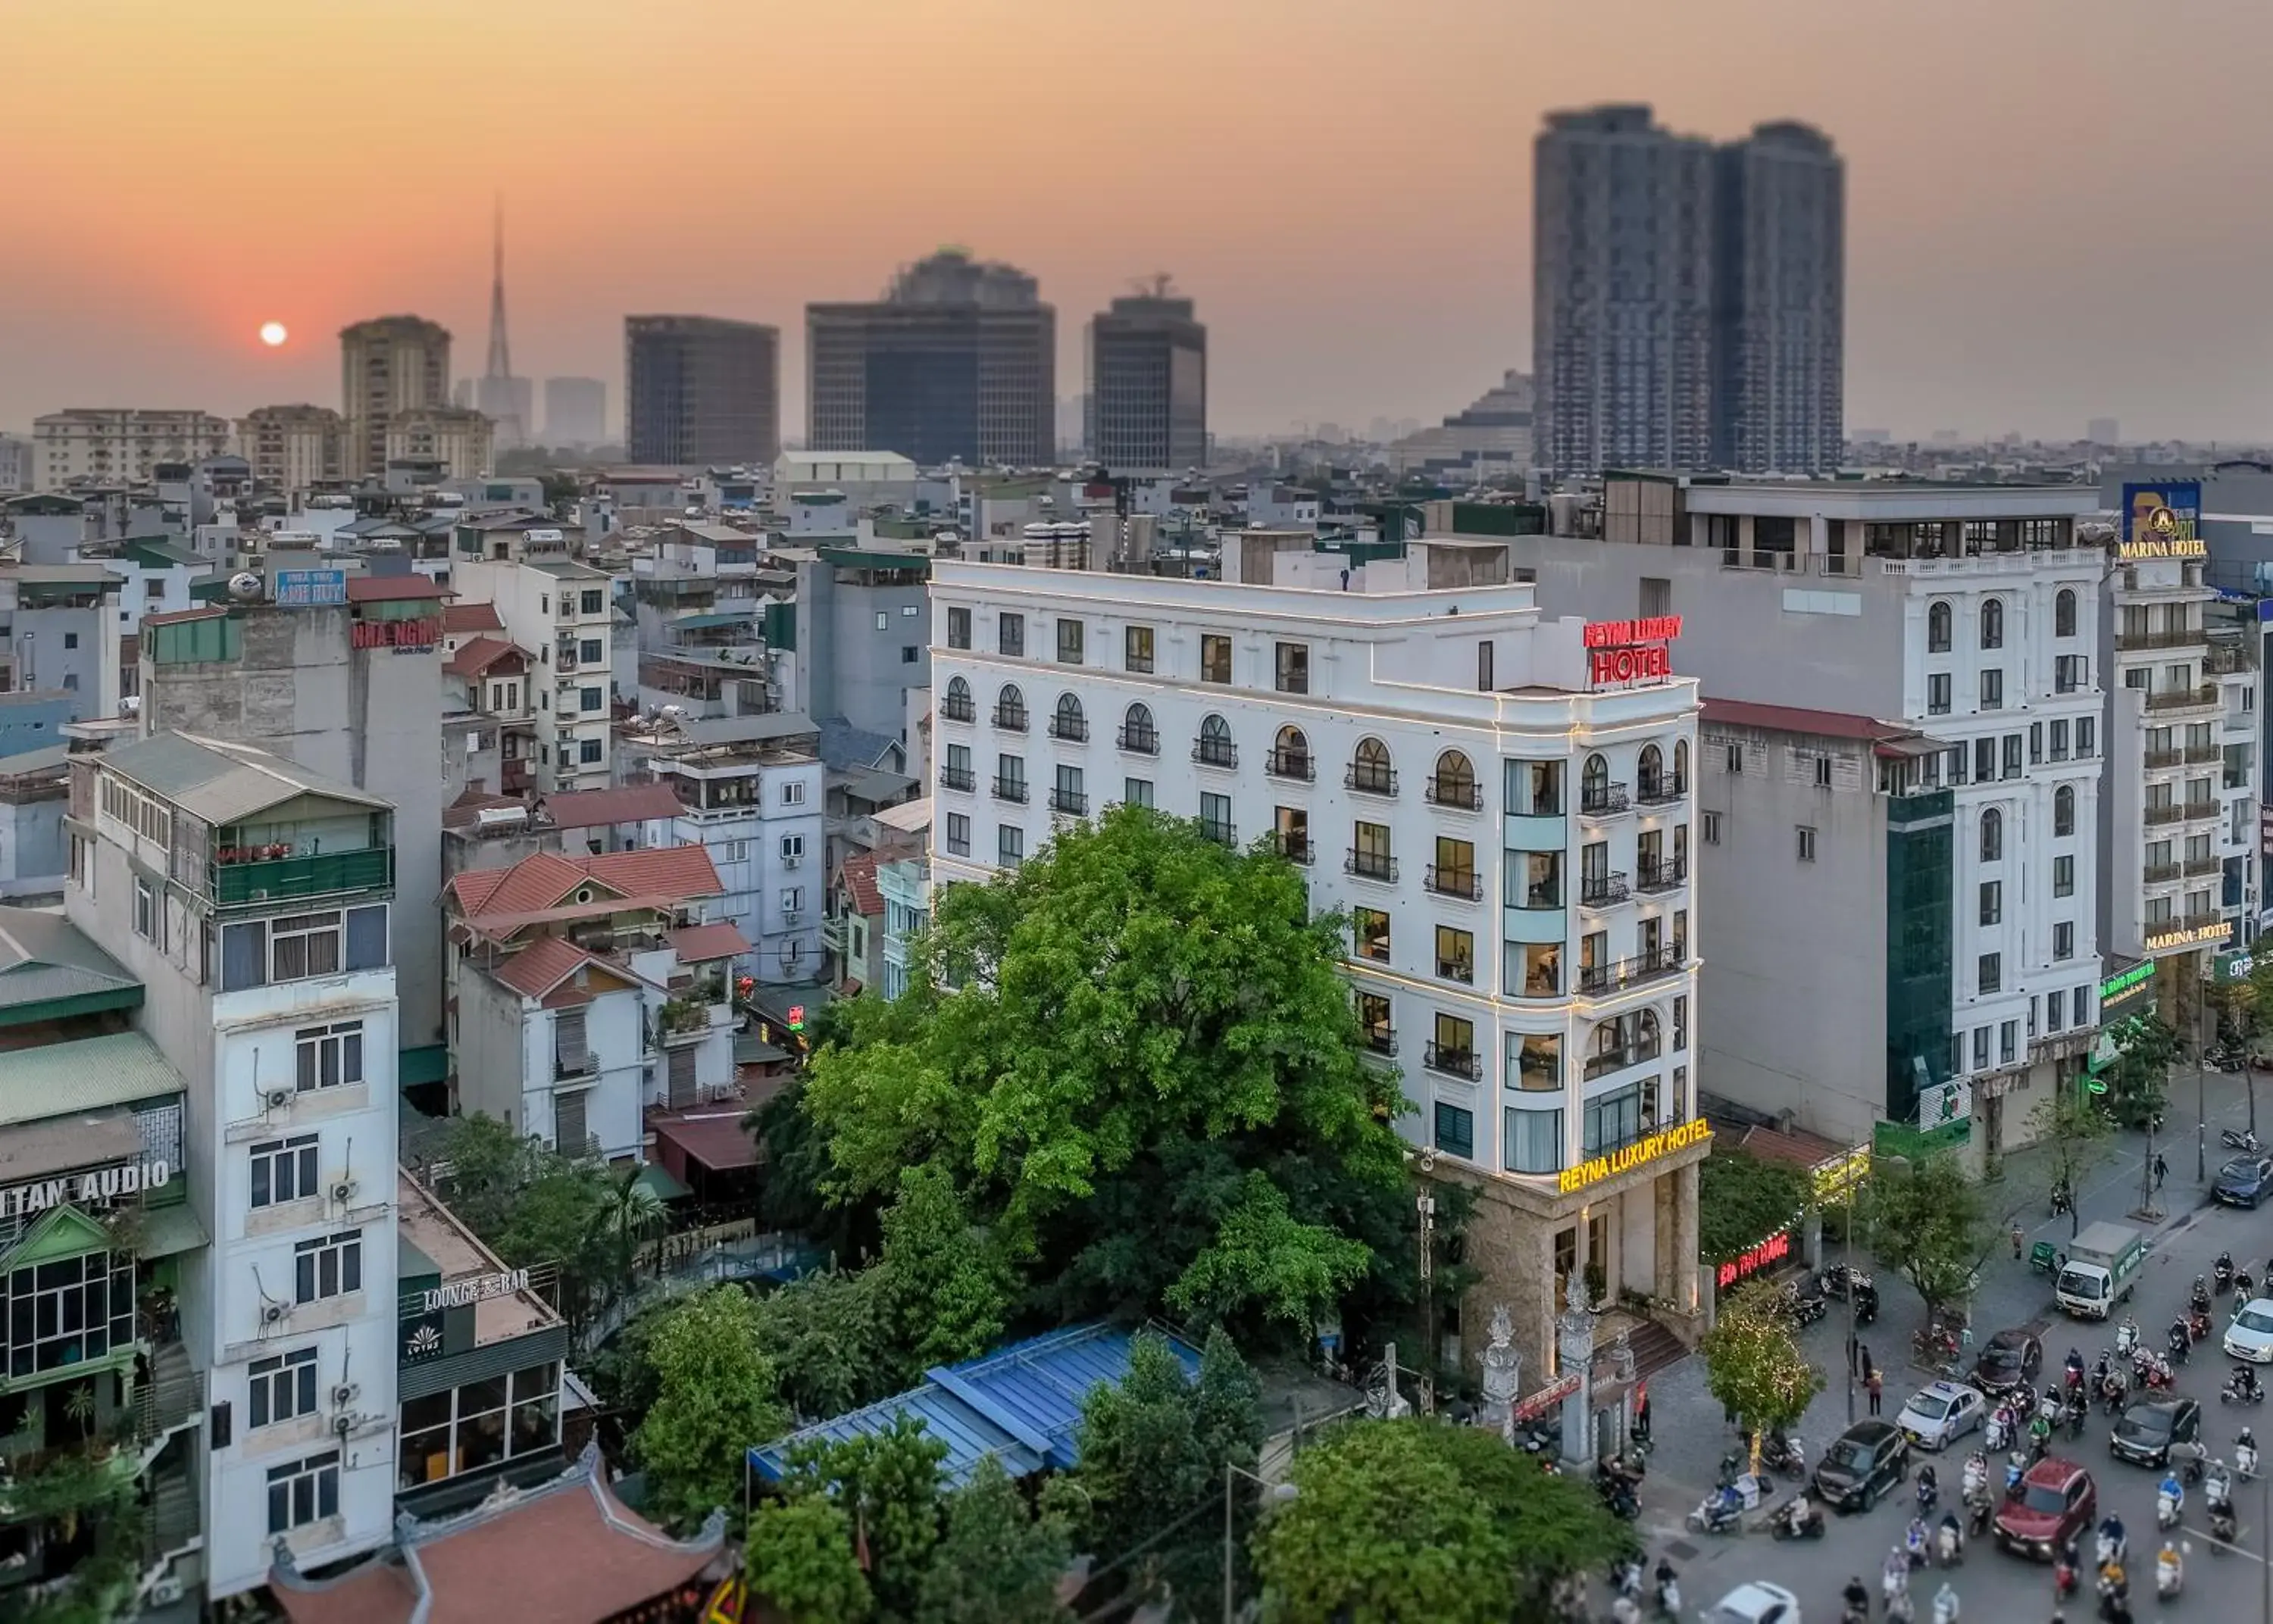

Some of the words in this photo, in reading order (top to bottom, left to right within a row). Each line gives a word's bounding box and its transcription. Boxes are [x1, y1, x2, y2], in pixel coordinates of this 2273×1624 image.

[2119, 542, 2169, 558] MARINA
[2170, 539, 2206, 556] HOTEL
[1592, 645, 1672, 685] HOTEL
[2145, 929, 2194, 951] MARINA
[2197, 921, 2234, 941] HOTEL
[1559, 1157, 1609, 1194] REYNA
[1611, 1134, 1665, 1173] LUXURY
[1667, 1117, 1715, 1152] HOTEL
[79, 1160, 170, 1202] AUDIO
[424, 1280, 480, 1312] LOUNGE
[499, 1268, 530, 1293] BAR
